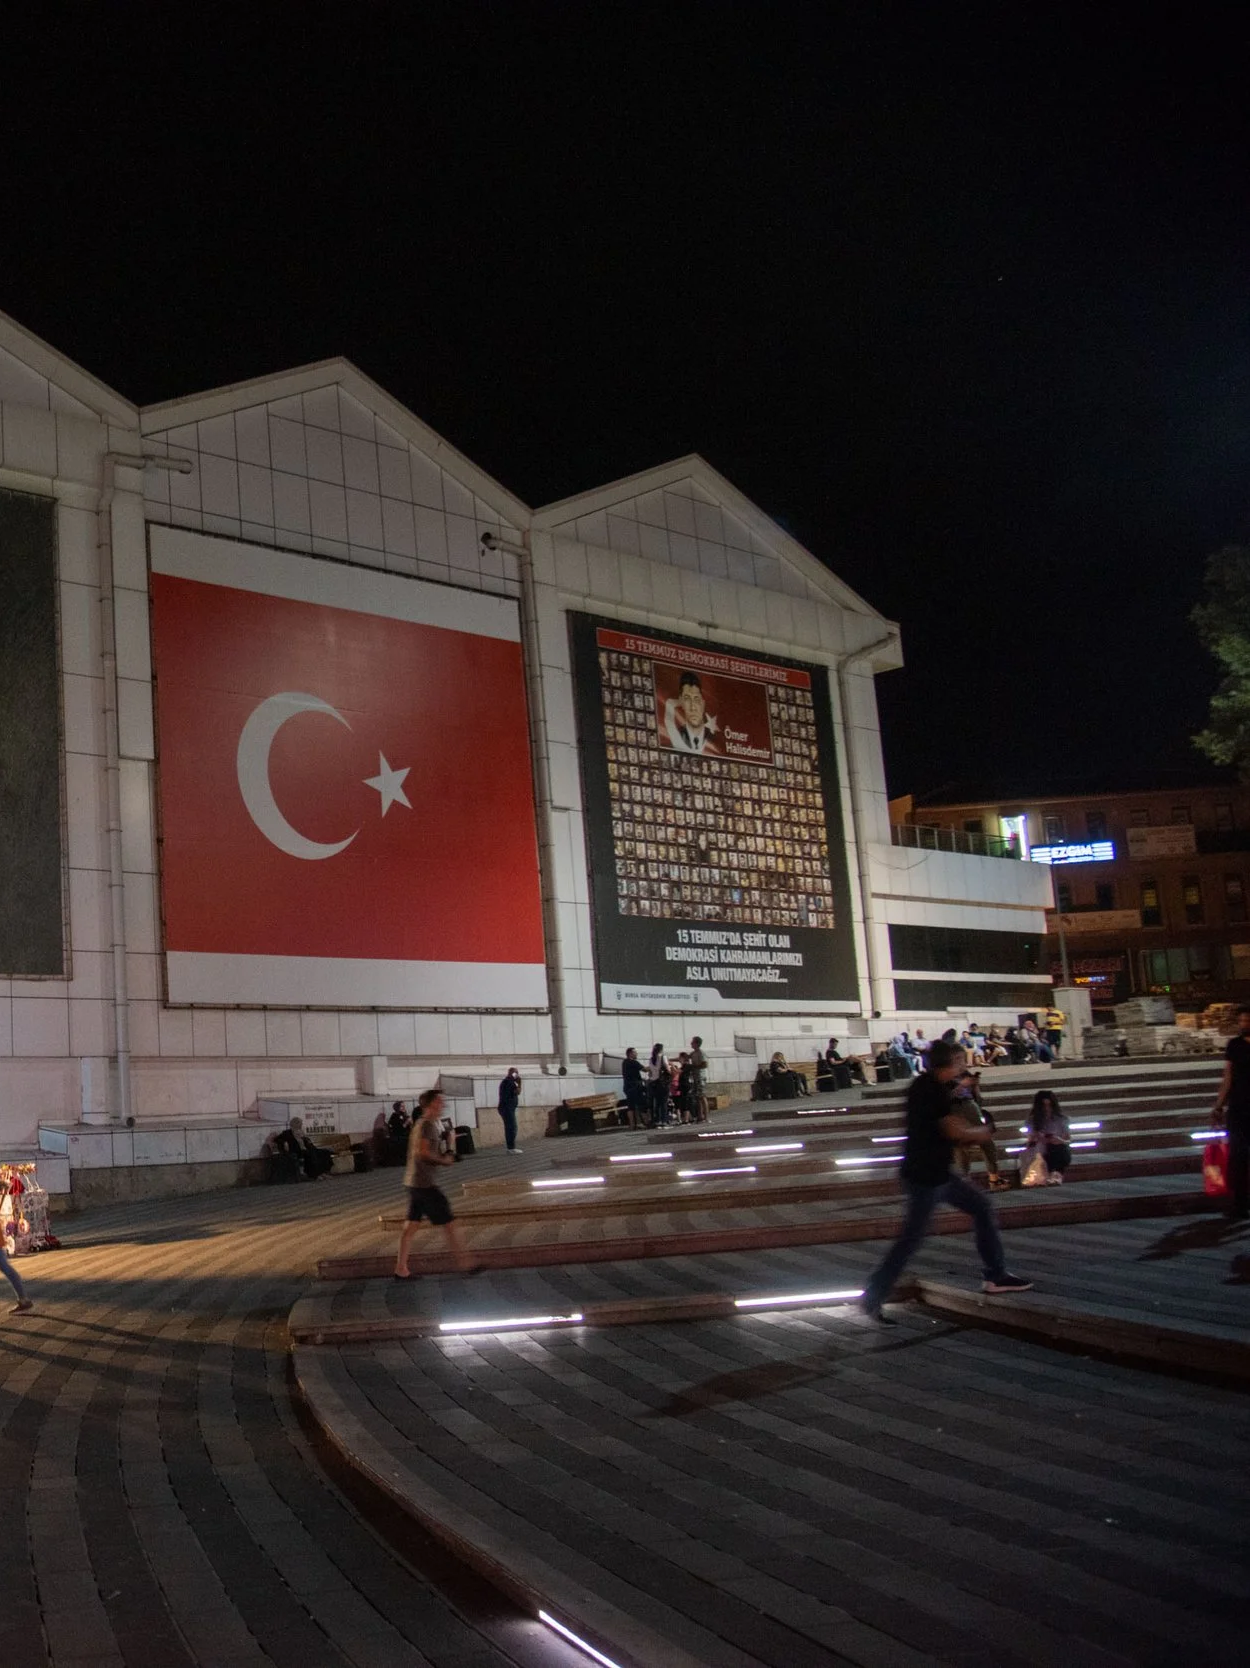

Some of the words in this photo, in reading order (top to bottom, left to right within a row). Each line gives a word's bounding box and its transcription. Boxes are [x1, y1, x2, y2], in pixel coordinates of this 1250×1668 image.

[625, 638, 636, 650] 15
[636, 640, 677, 659] TEMMUZ
[678, 650, 730, 670] DEMOKRASİ
[724, 725, 748, 742] Ömer
[676, 929, 688, 943] 15
[689, 930, 742, 946] TEMMUZ'DA
[742, 930, 767, 949] ŞEHİT
[768, 933, 791, 948] OLAN
[665, 946, 719, 962] DEMOKRASİ
[720, 950, 803, 966] KAHRAMANLARIMIZI
[686, 966, 710, 981] ASLA
